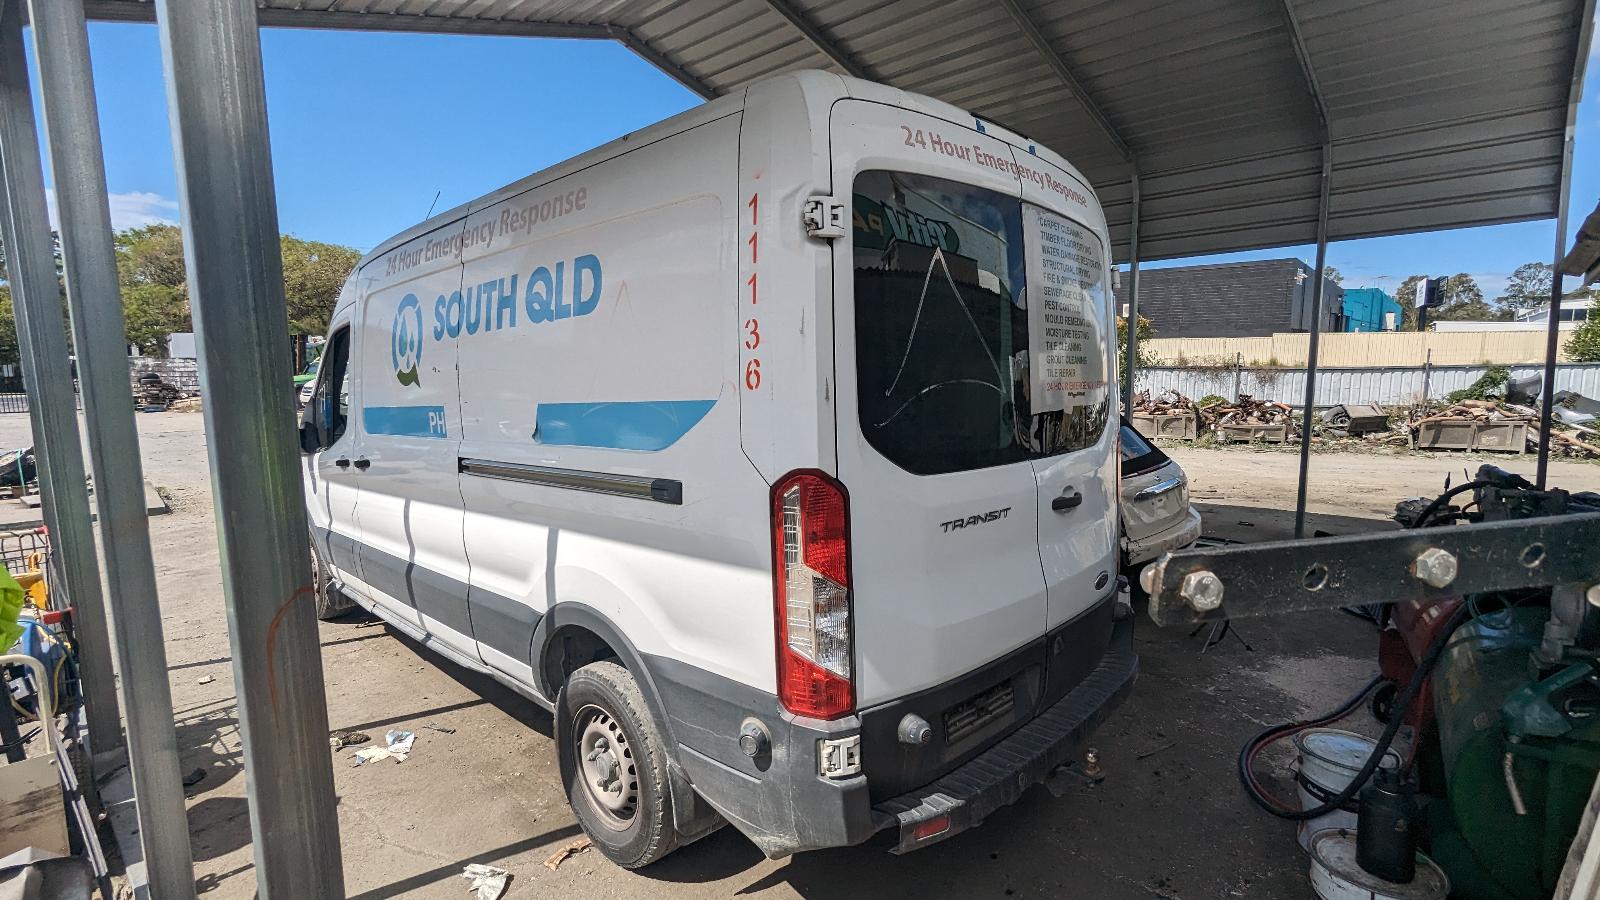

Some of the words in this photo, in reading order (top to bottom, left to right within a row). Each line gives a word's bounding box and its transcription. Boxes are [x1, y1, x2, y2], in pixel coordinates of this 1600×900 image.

[901, 126, 926, 149] 24
[929, 132, 970, 161] Hour
[973, 145, 1044, 191] Emergency
[1046, 173, 1089, 208] Response
[1040, 217, 1060, 231] CARPET
[386, 251, 398, 276] 24
[399, 247, 426, 271] Hour
[425, 217, 498, 260] Emergency
[499, 186, 588, 236] Response
[1040, 231, 1060, 244] TIMBER
[1041, 245, 1060, 258] WATER
[433, 274, 518, 341] SOUTH
[525, 253, 603, 324] QLD
[1044, 300, 1058, 311] PEST
[1044, 313, 1064, 325] MOULD
[1045, 327, 1071, 339] MOISTURE
[1046, 341, 1057, 351] TILE
[1047, 368, 1059, 378] TILE
[428, 411, 446, 435] PH
[940, 507, 1011, 533] TRANSIT
